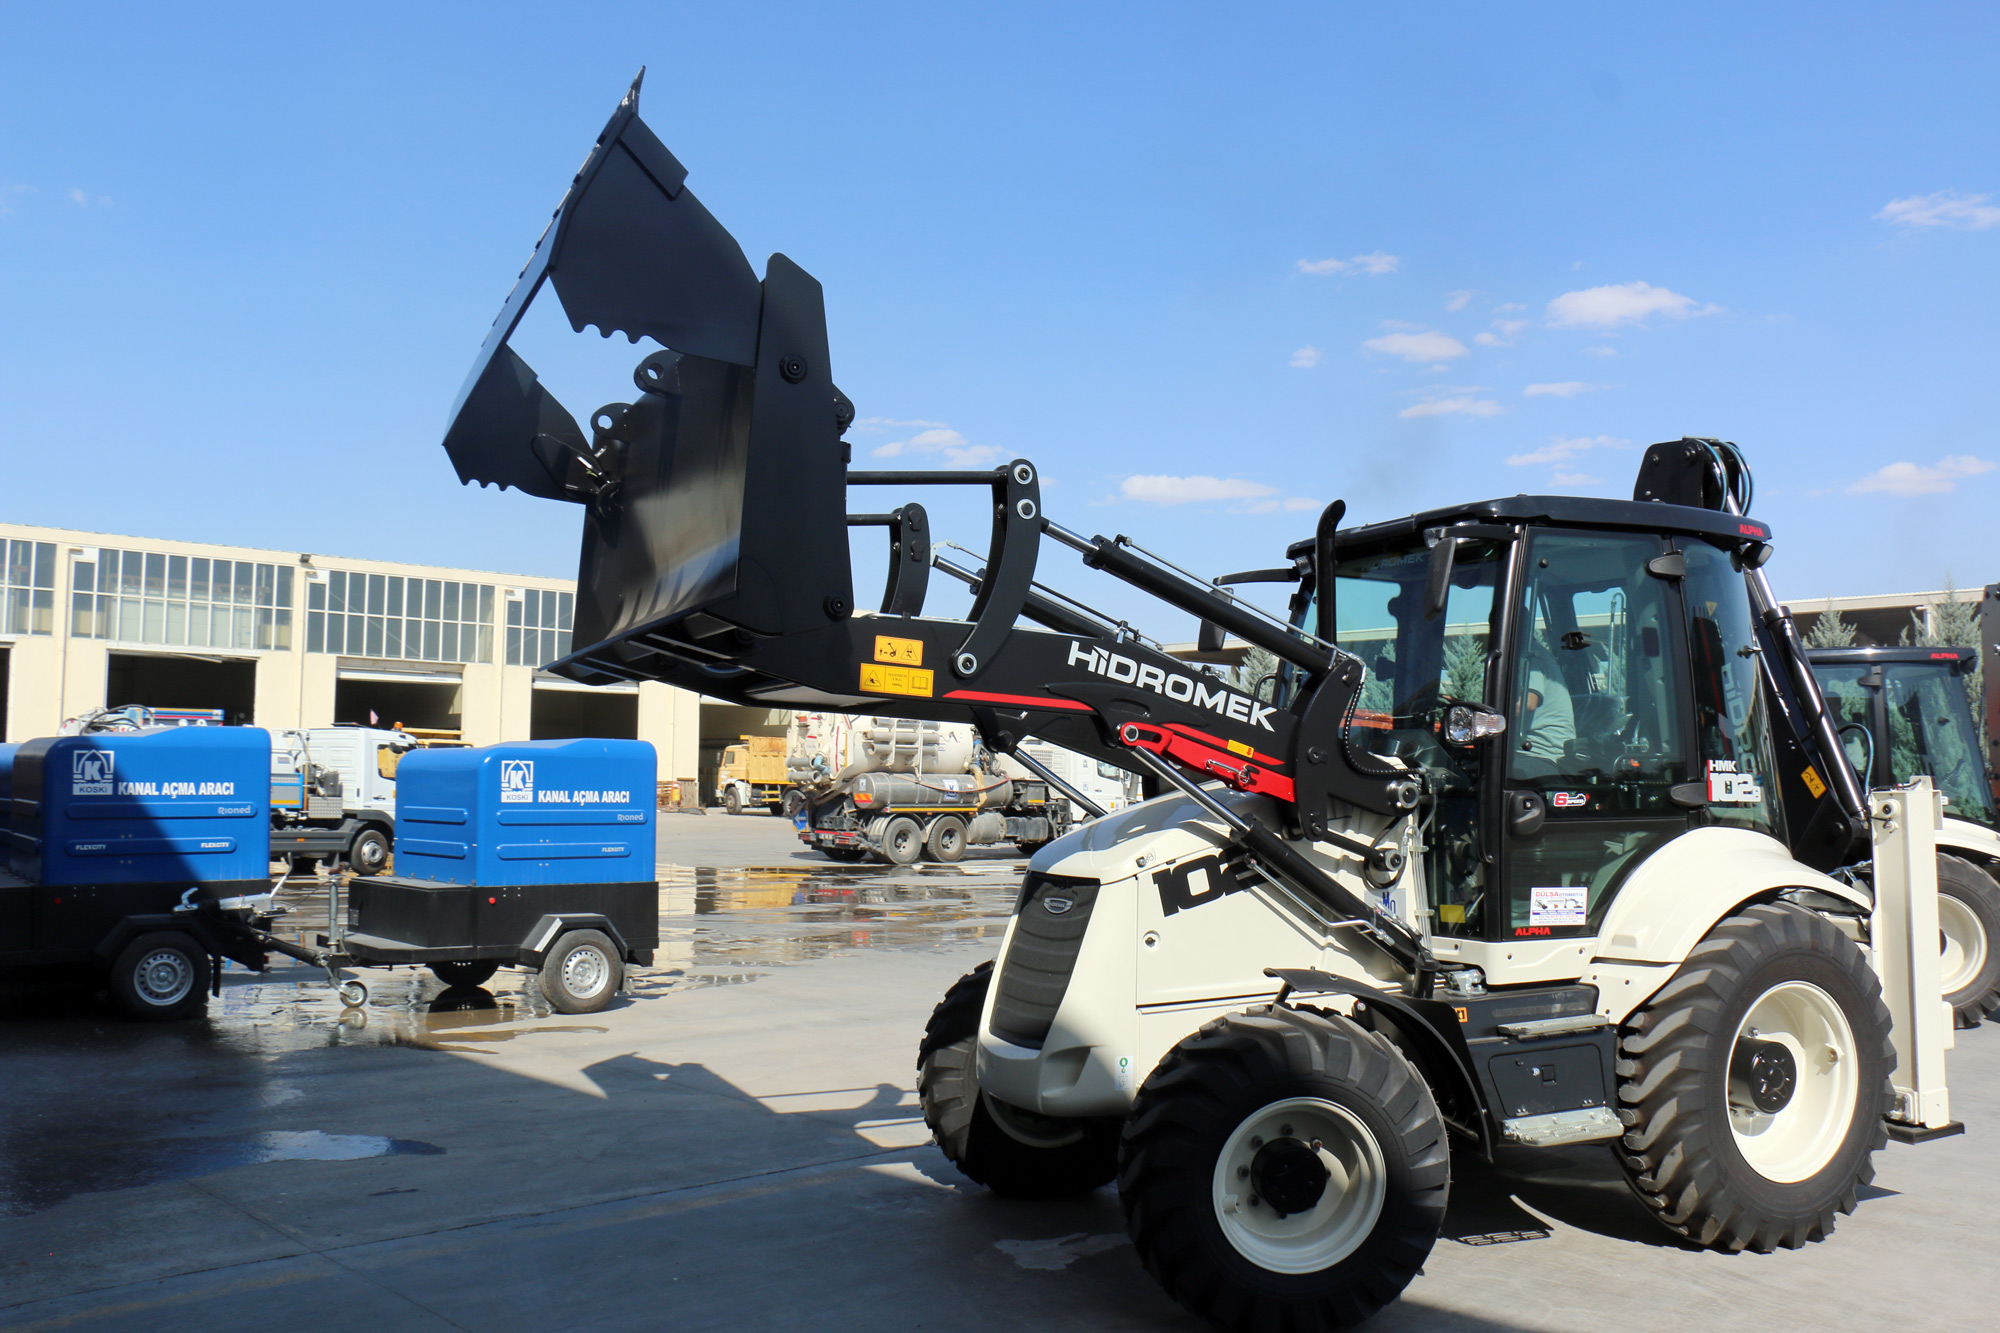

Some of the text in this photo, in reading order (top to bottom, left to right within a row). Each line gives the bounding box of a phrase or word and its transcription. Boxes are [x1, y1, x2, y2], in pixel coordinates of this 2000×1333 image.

[1739, 523, 1765, 538] ALPHA
[1709, 760, 1738, 772] HMK
[118, 782, 235, 799] KANAL AÇMA ARACI
[538, 790, 630, 806] KANAL AÇMA ARACI
[1515, 927, 1551, 936] ALPHA
